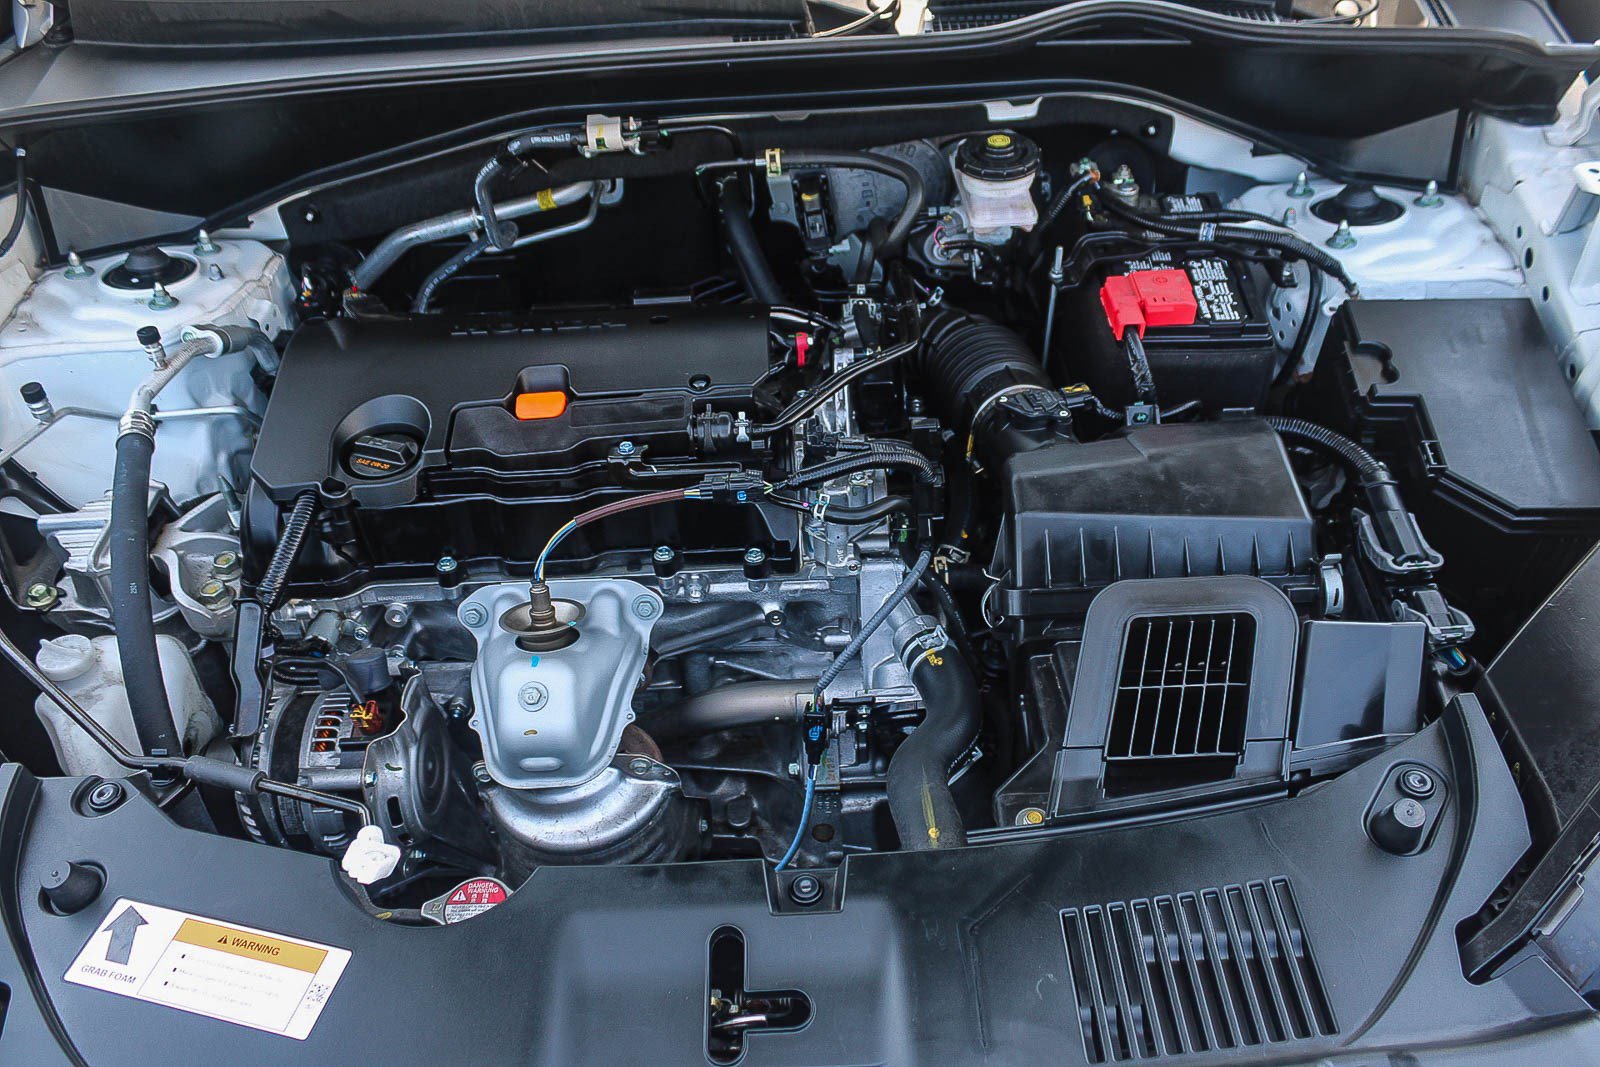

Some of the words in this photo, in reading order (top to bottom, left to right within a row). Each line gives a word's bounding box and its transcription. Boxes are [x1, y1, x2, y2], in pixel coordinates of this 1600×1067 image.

[232, 936, 280, 956] WARNING
[81, 965, 108, 977] GRAB
[108, 971, 136, 984] FOAM
